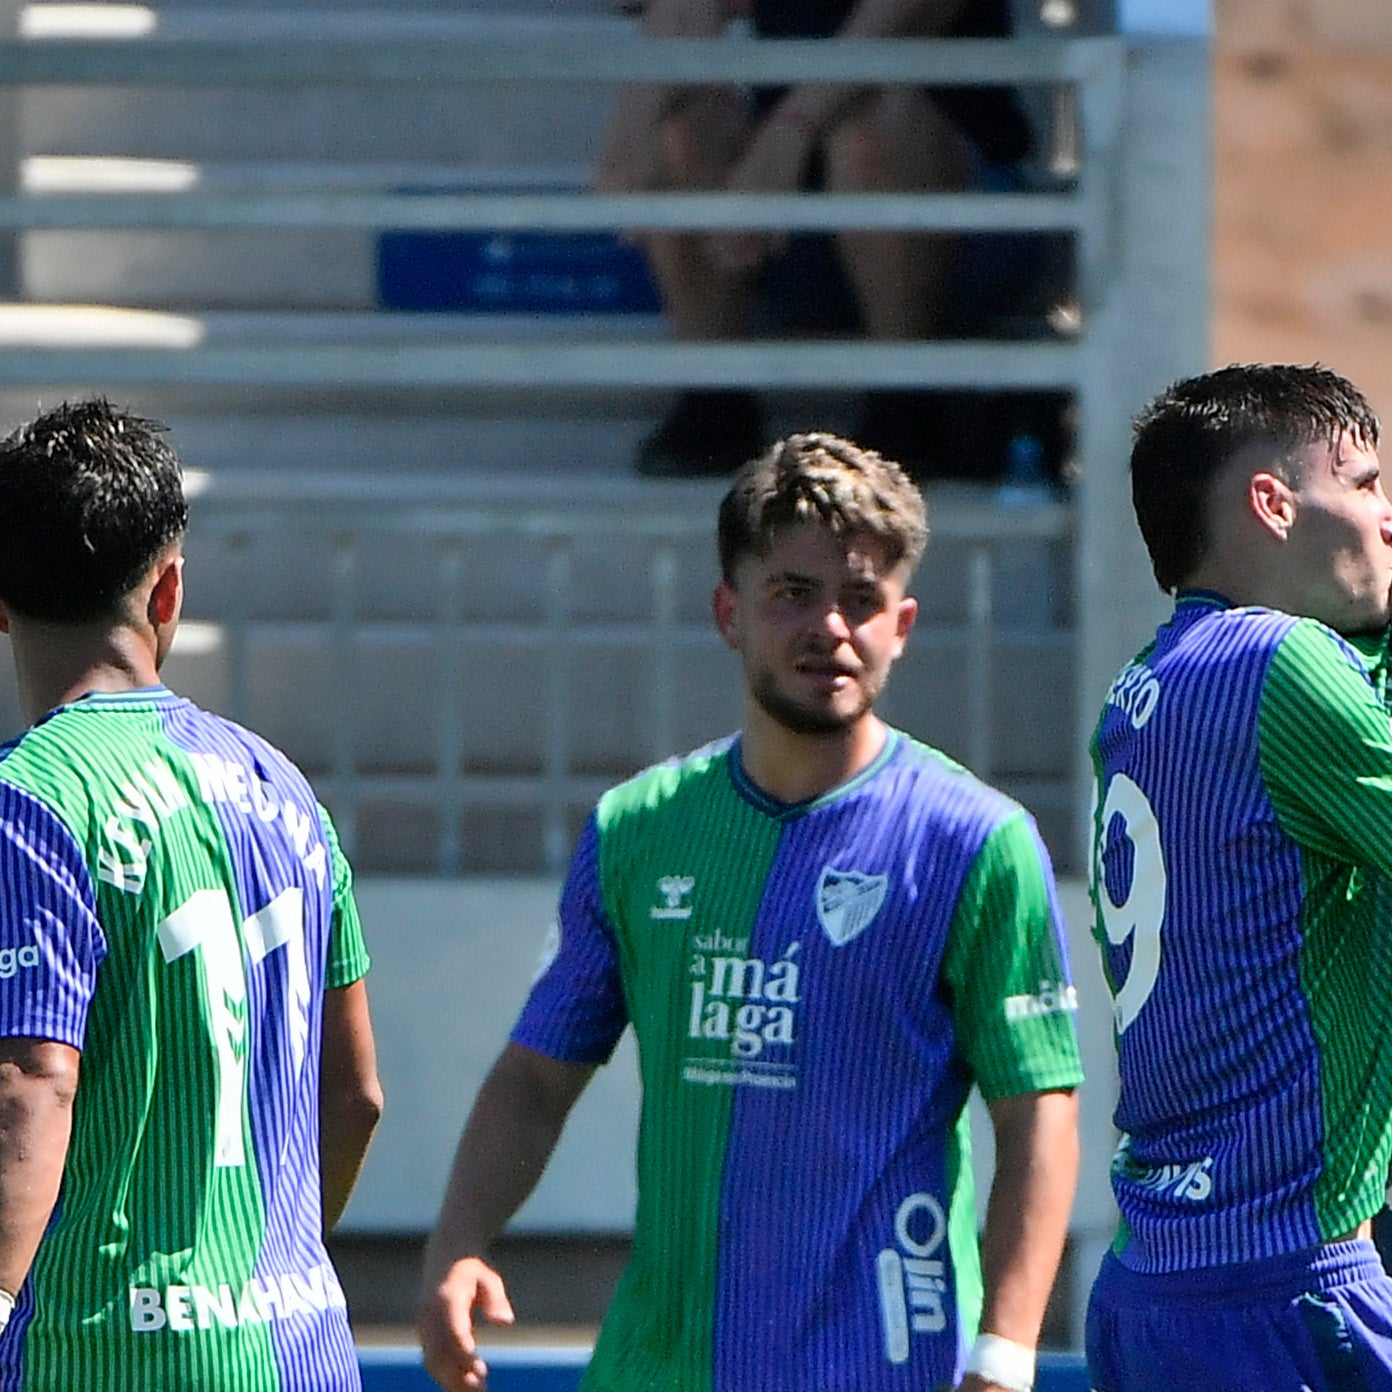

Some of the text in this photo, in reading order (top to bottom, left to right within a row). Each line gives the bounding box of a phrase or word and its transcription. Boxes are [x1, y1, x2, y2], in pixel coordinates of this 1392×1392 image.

[709, 940, 801, 1003] má
[157, 887, 311, 1167] 11
[688, 981, 795, 1057] laga
